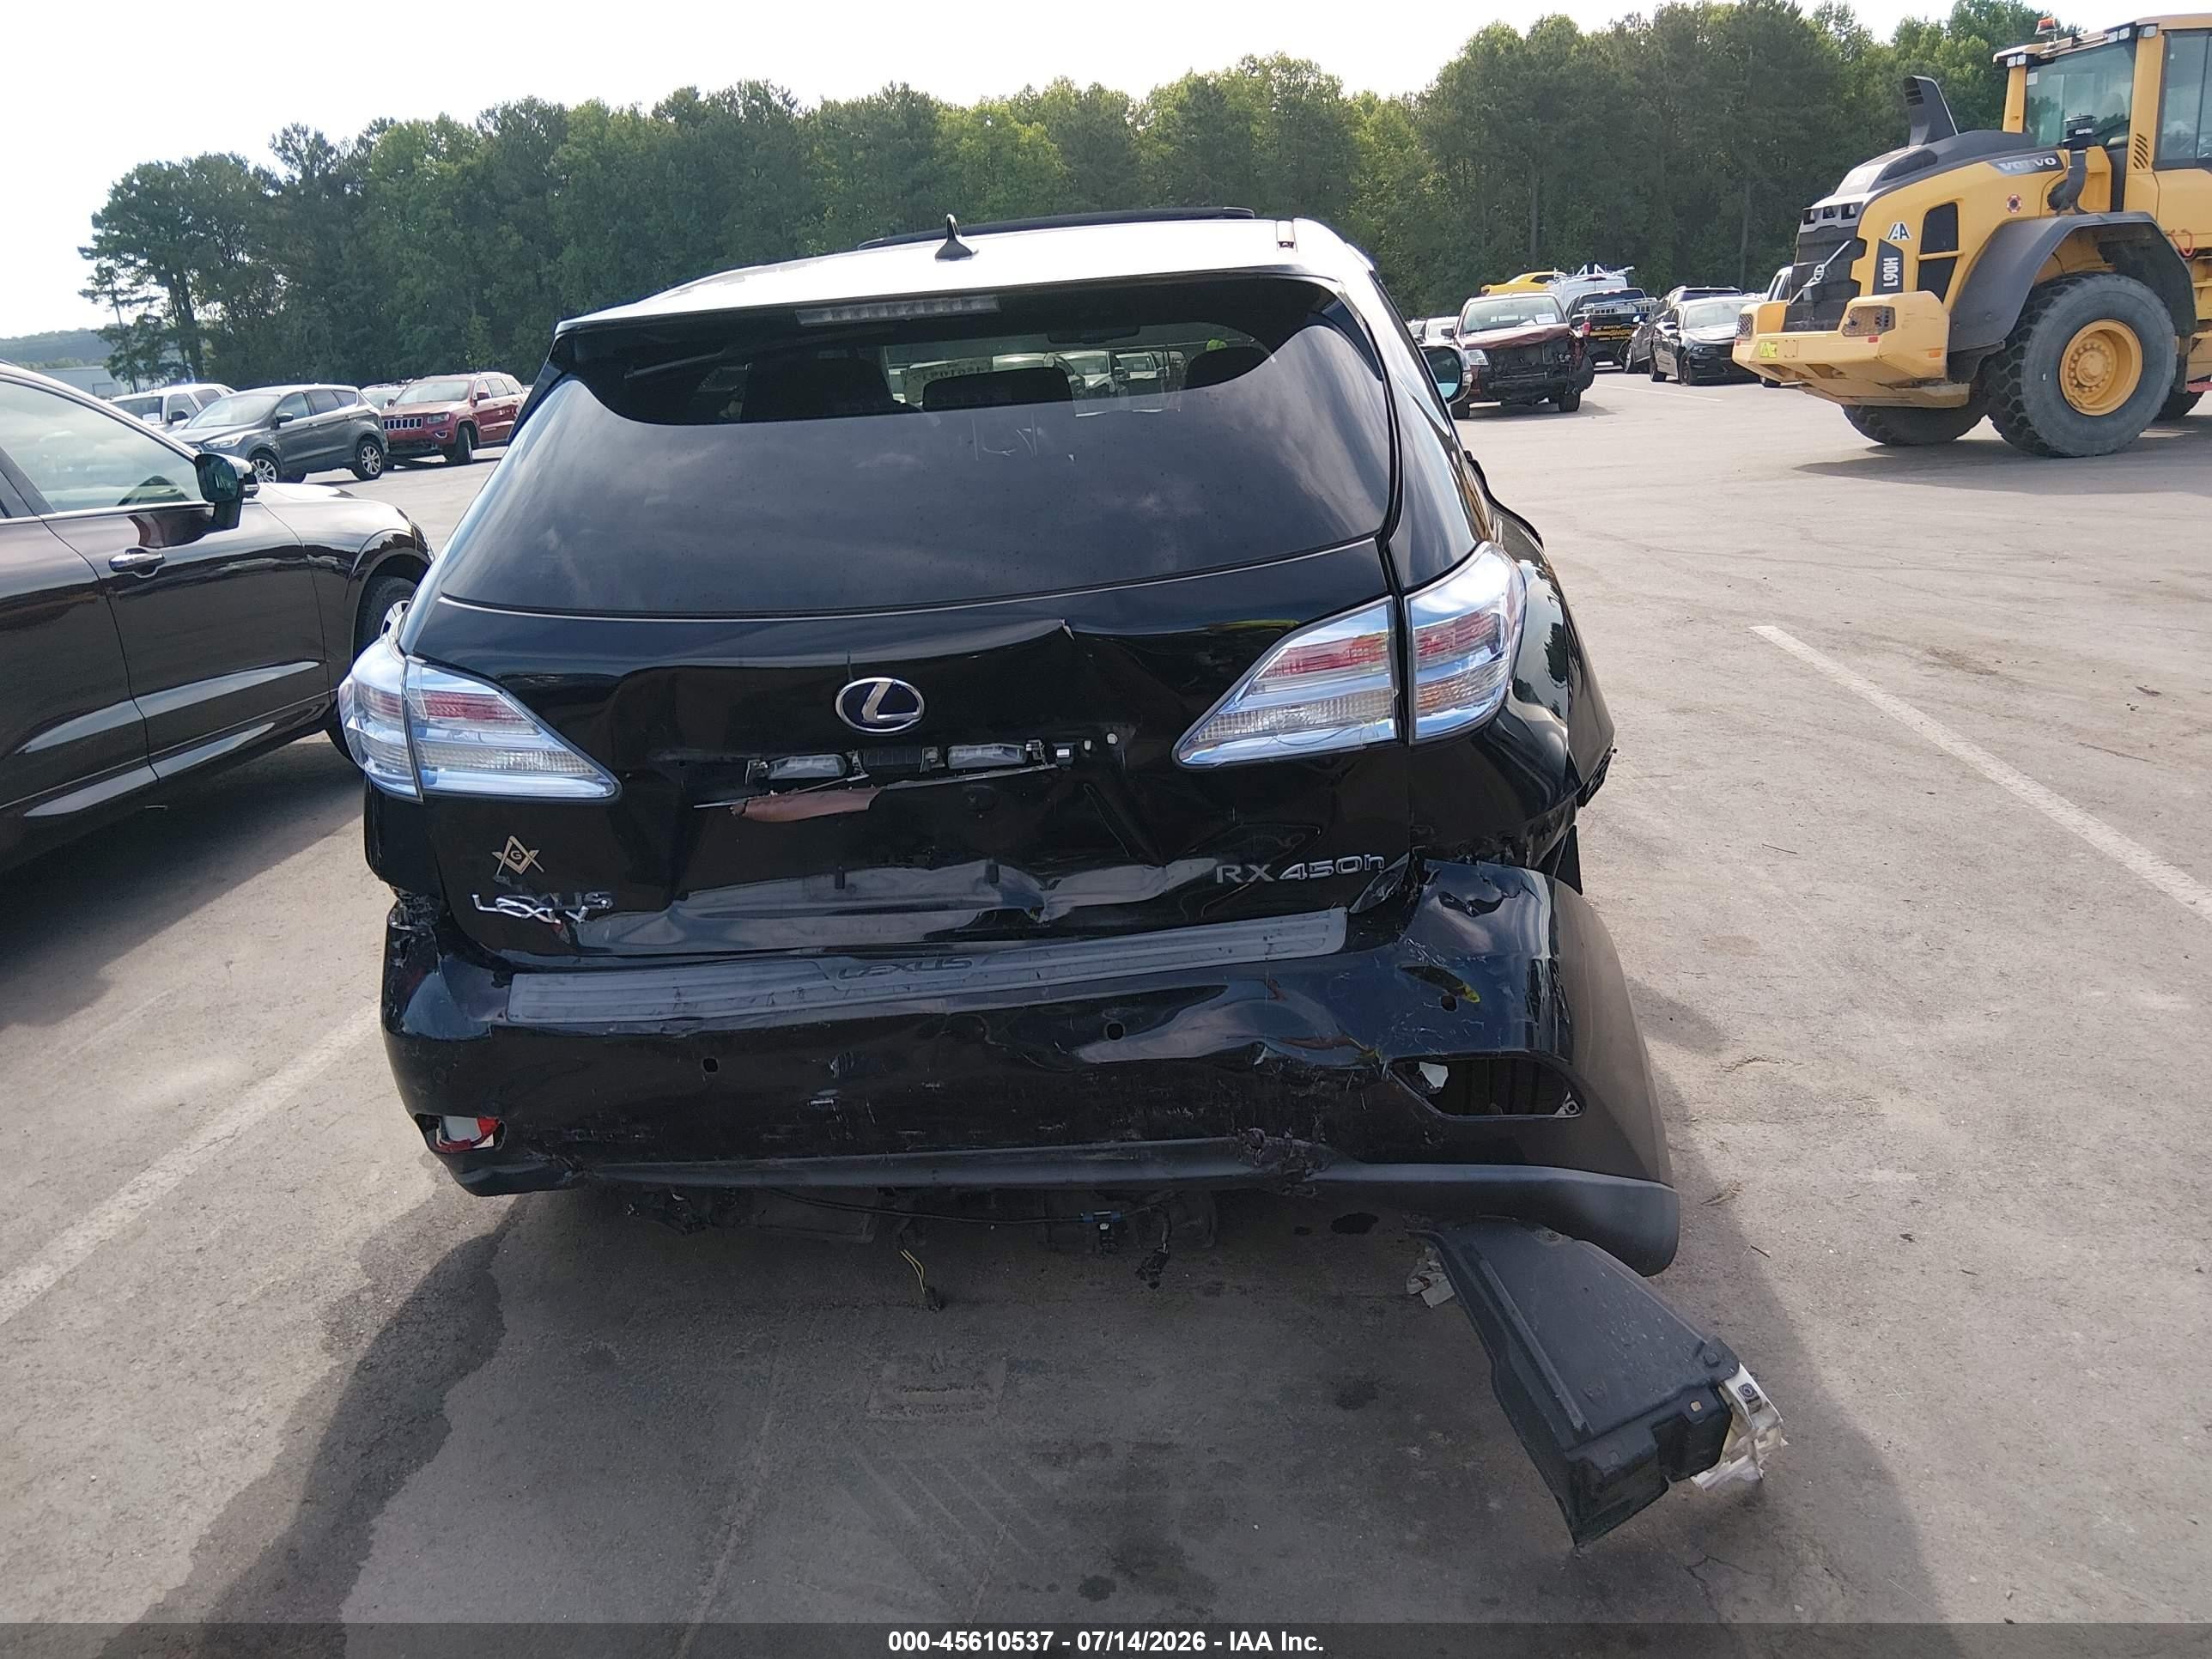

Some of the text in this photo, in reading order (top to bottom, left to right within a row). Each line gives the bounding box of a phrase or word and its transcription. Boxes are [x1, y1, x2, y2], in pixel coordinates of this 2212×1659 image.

[1998, 157, 2057, 171] VOLVO
[1883, 257, 1899, 287] L90H
[1216, 864, 1275, 884] RX
[837, 957, 974, 981] LEXUS
